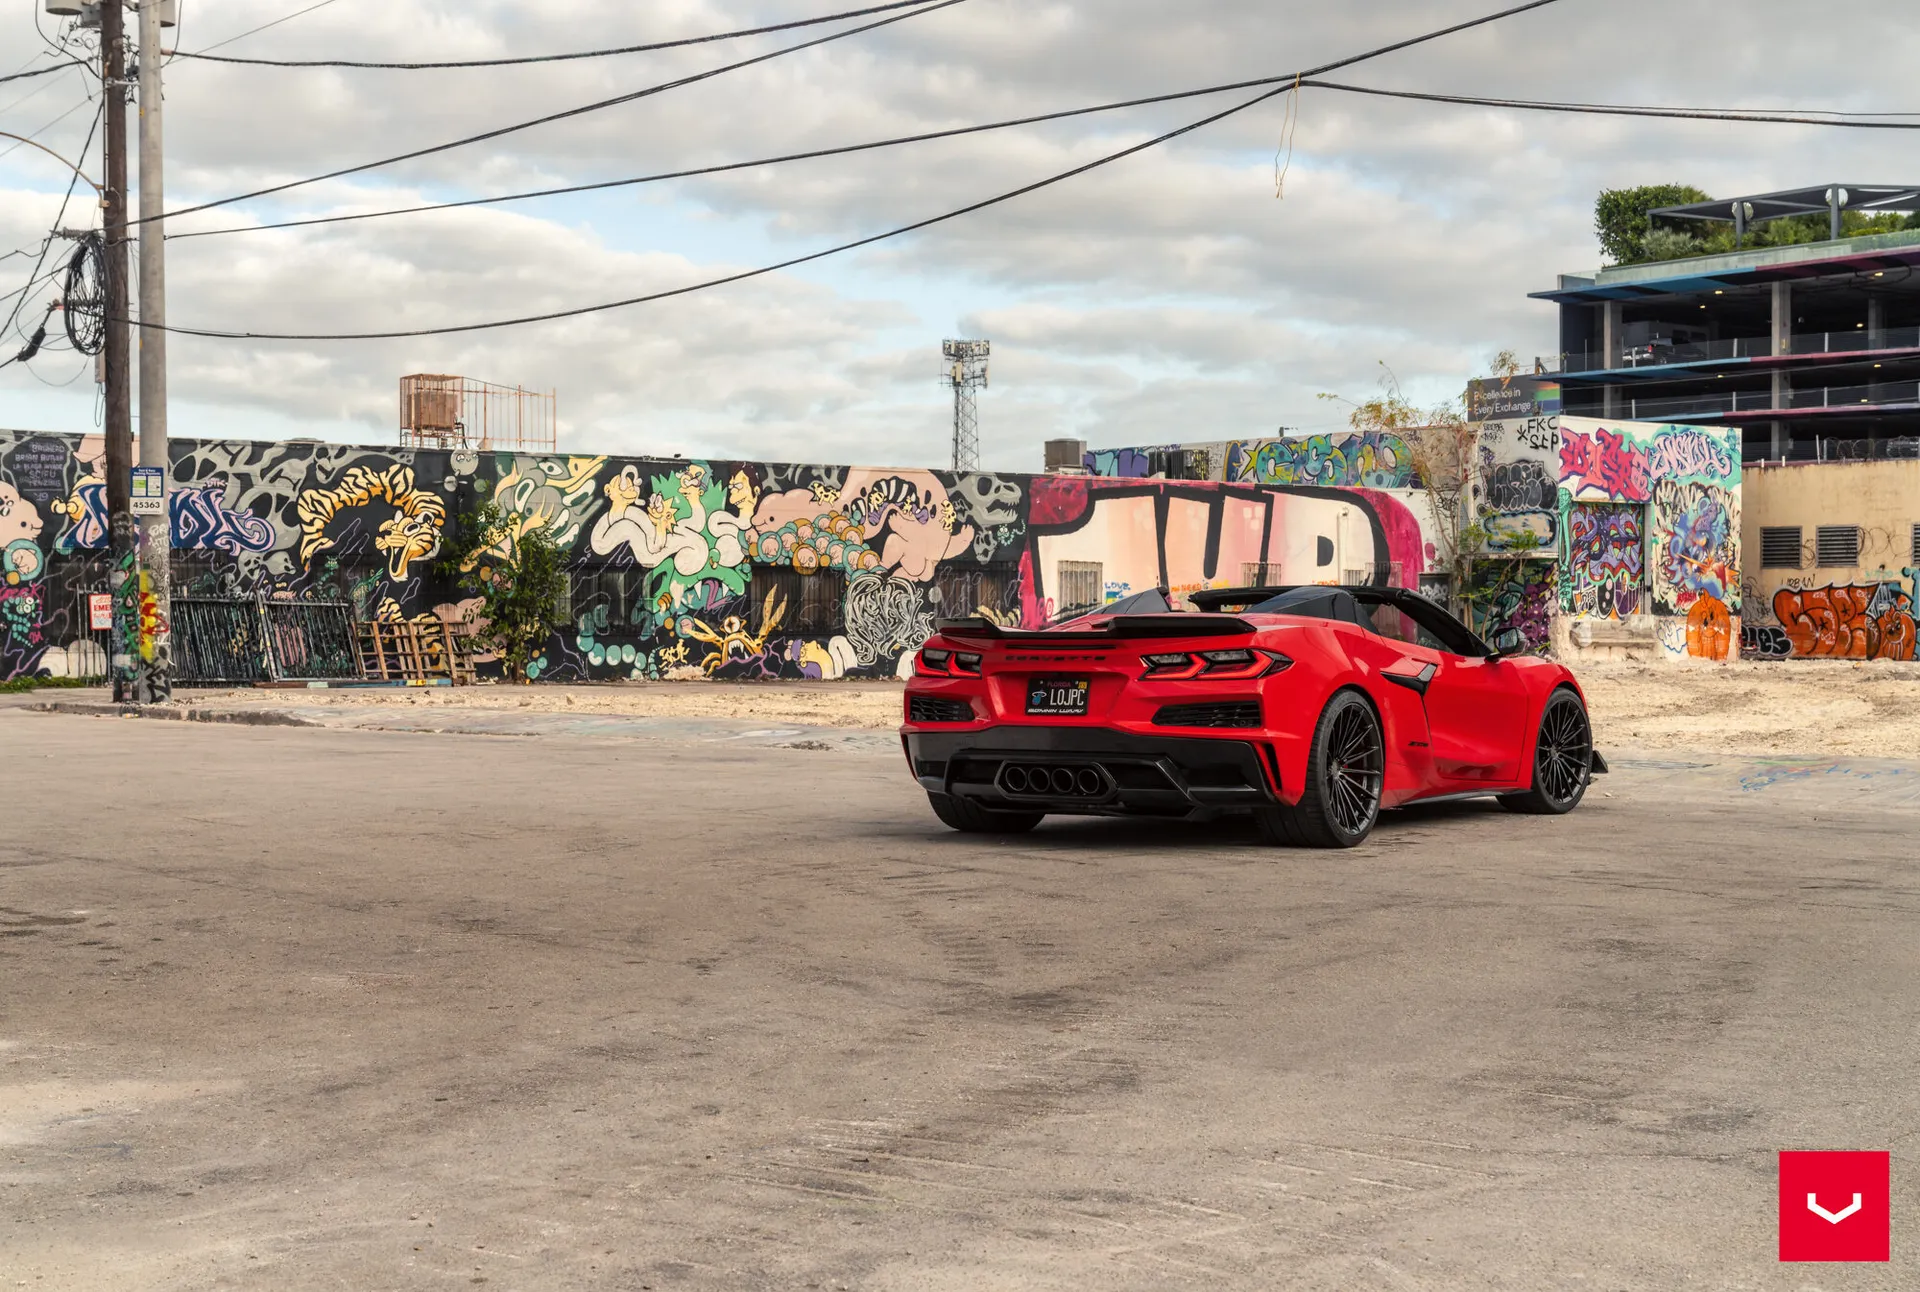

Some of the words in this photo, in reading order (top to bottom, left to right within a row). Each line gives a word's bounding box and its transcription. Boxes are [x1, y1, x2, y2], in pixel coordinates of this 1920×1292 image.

[1473, 389, 1512, 401] Ecellece
[1513, 387, 1521, 397] in
[133, 501, 161, 509] 45363
